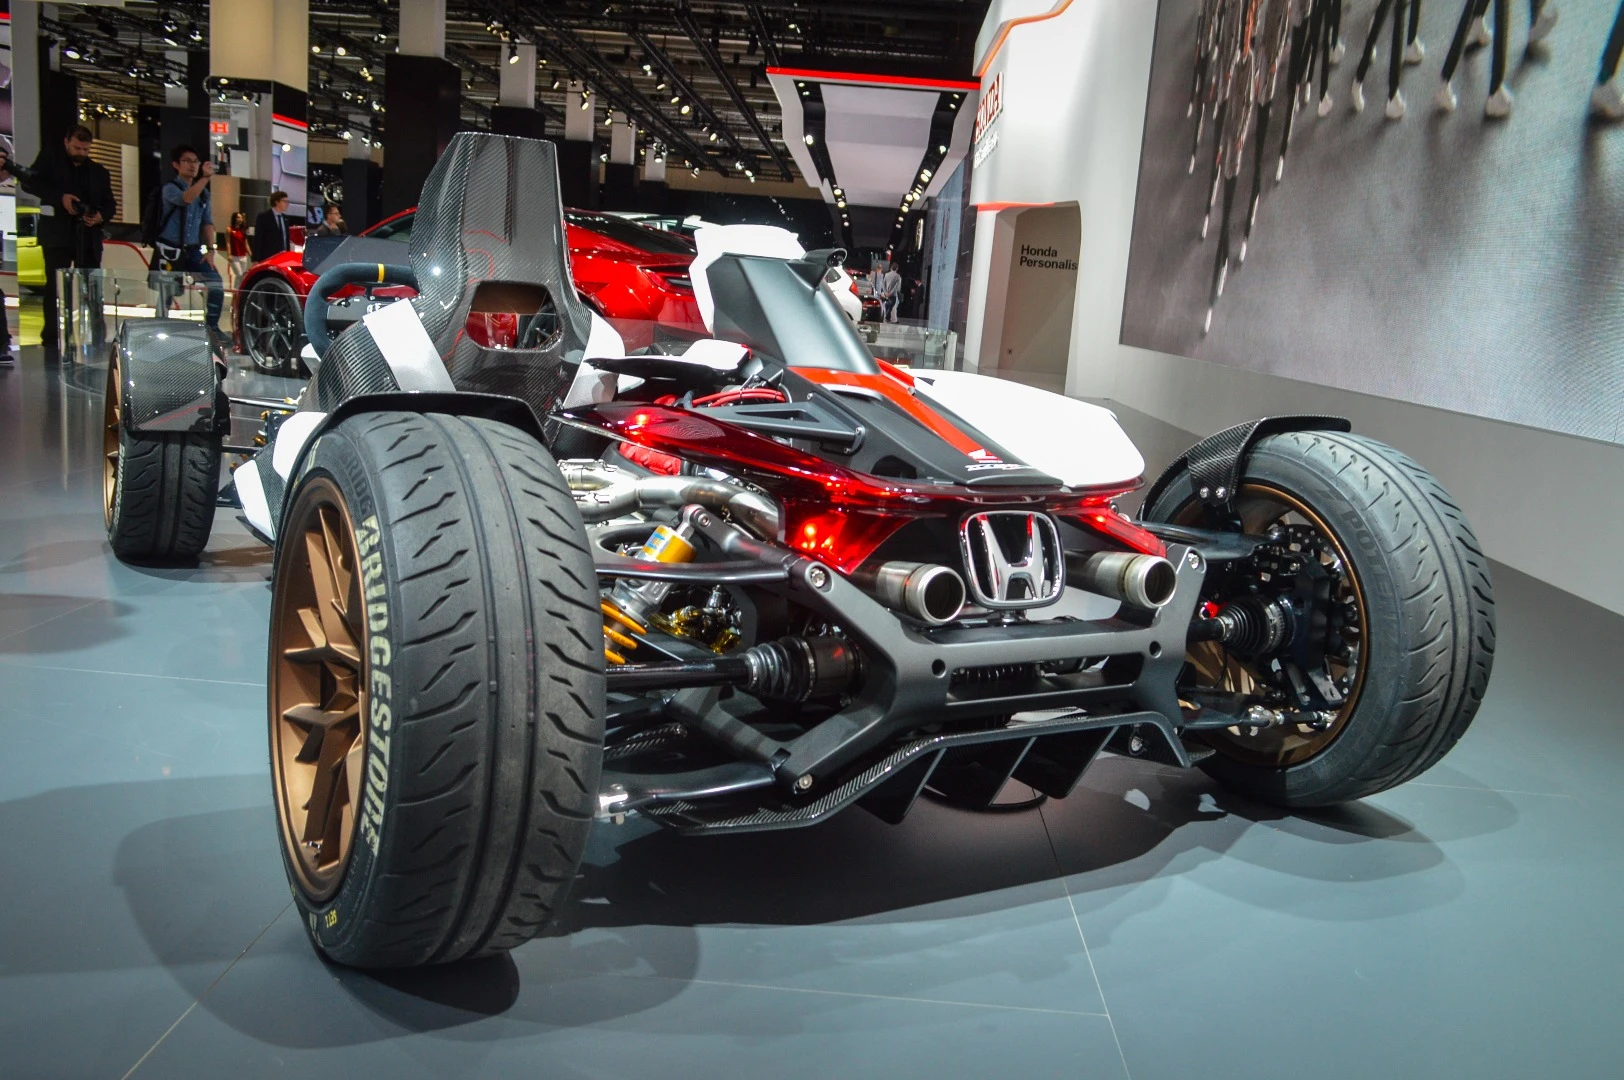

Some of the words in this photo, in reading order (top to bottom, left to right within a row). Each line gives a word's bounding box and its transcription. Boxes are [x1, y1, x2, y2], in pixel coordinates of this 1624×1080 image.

[1021, 244, 1058, 258] Honda
[1020, 256, 1079, 271] Personalis
[354, 514, 392, 856] BRIDGESTONE
